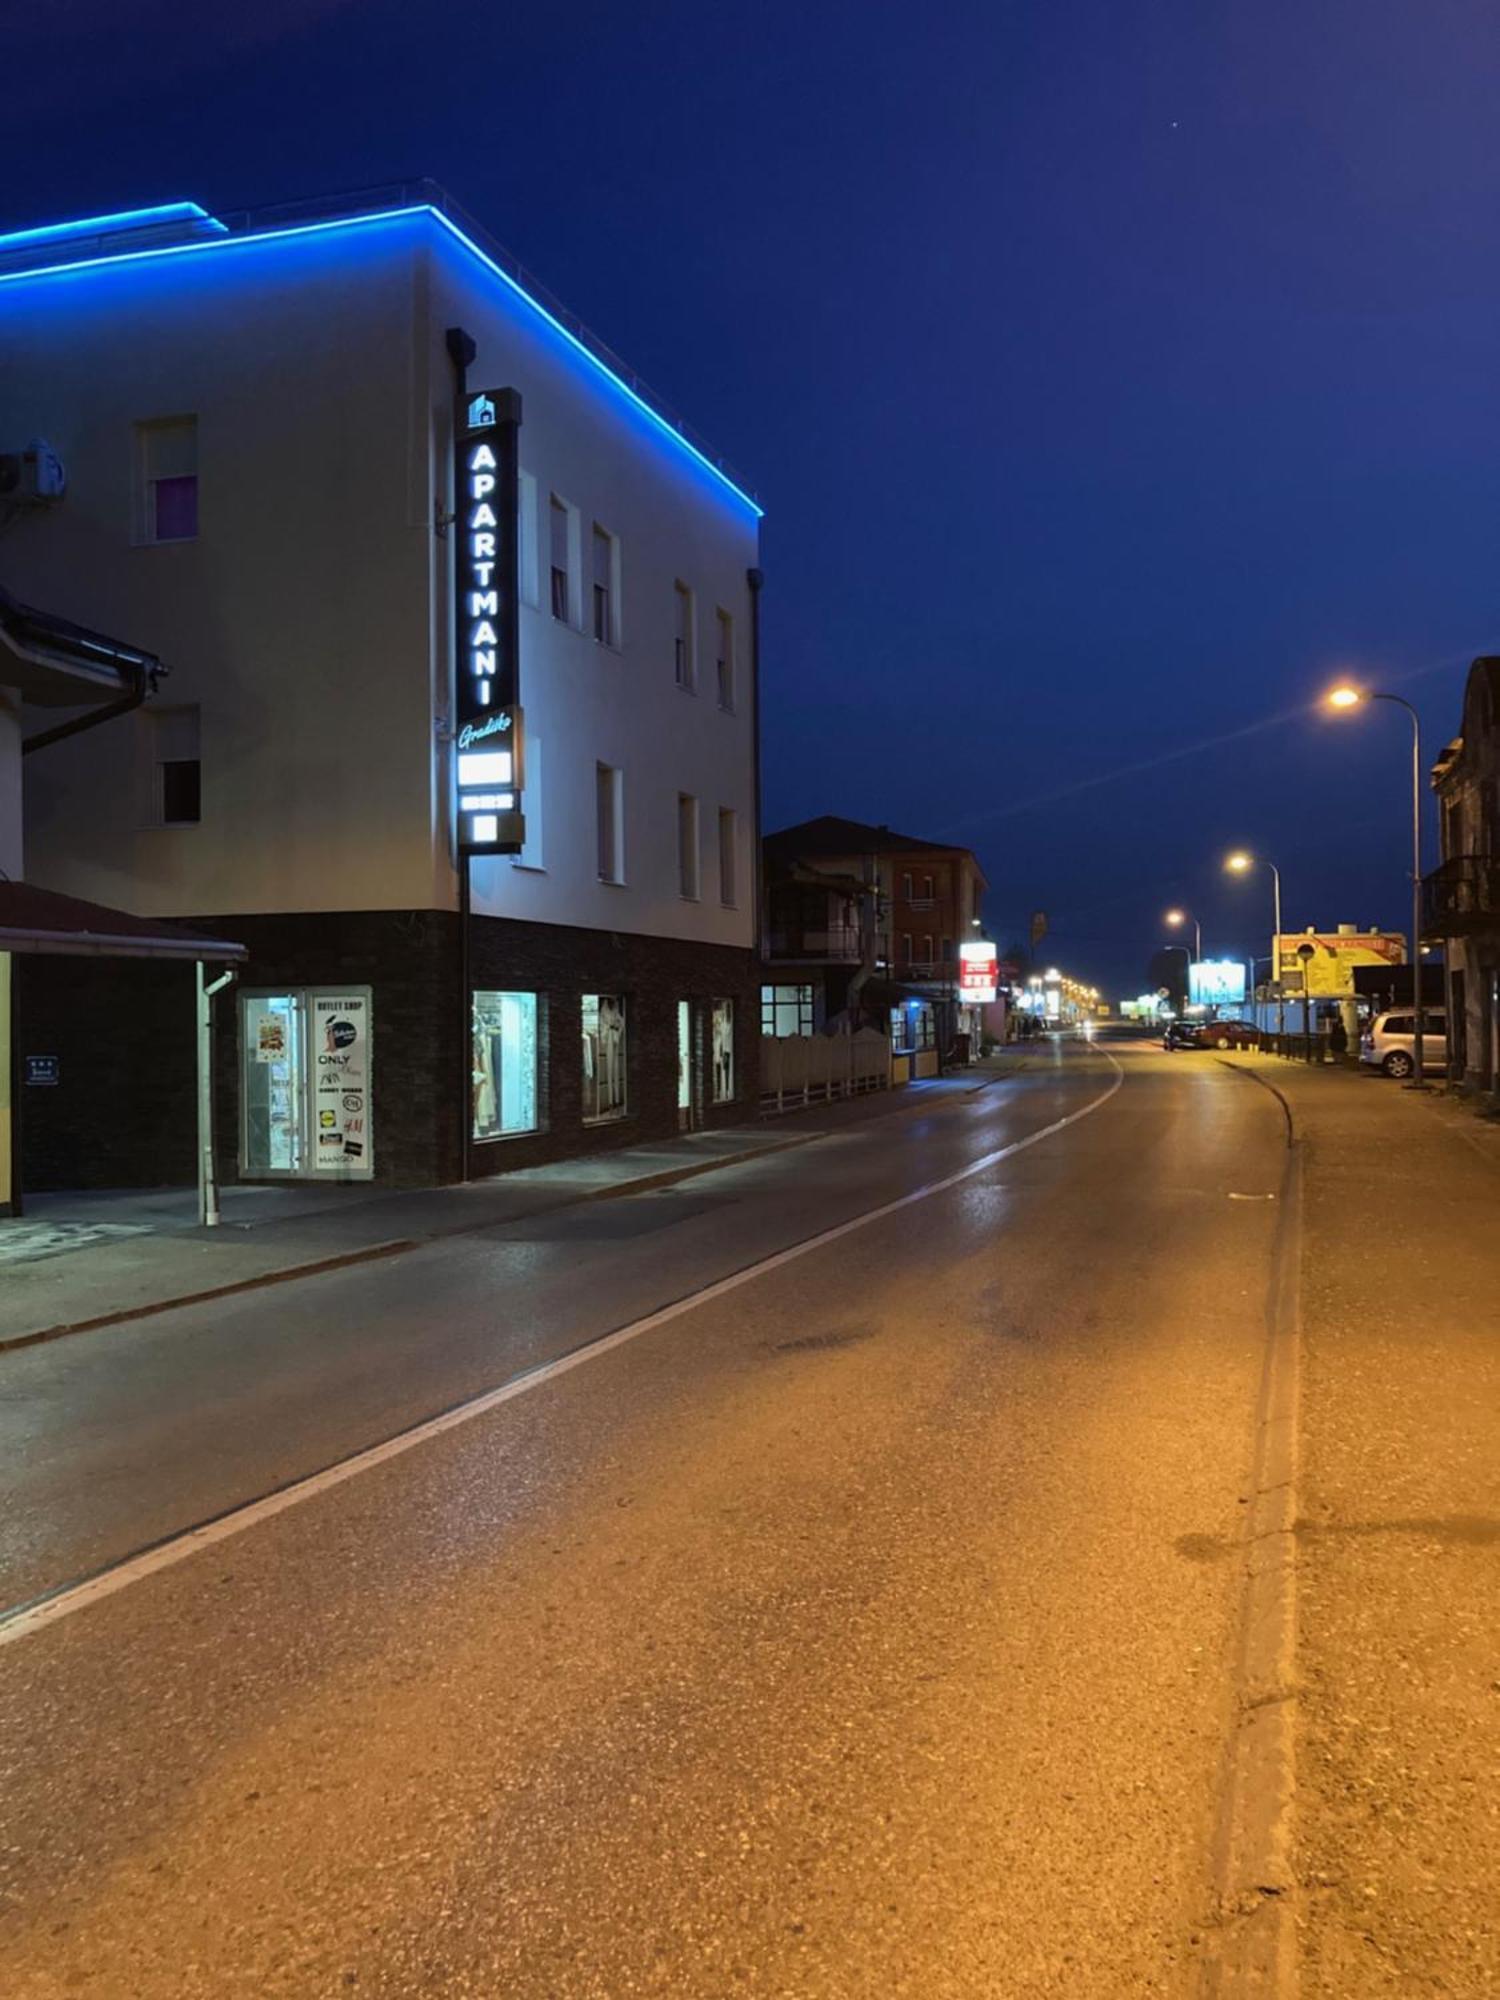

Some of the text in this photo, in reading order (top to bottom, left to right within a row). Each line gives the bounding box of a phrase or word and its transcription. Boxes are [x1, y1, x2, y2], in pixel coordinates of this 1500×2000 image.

[471, 444, 498, 705] APARTMANI
[344, 1001, 362, 1011] SHOP
[318, 1055, 350, 1065] ONLY
